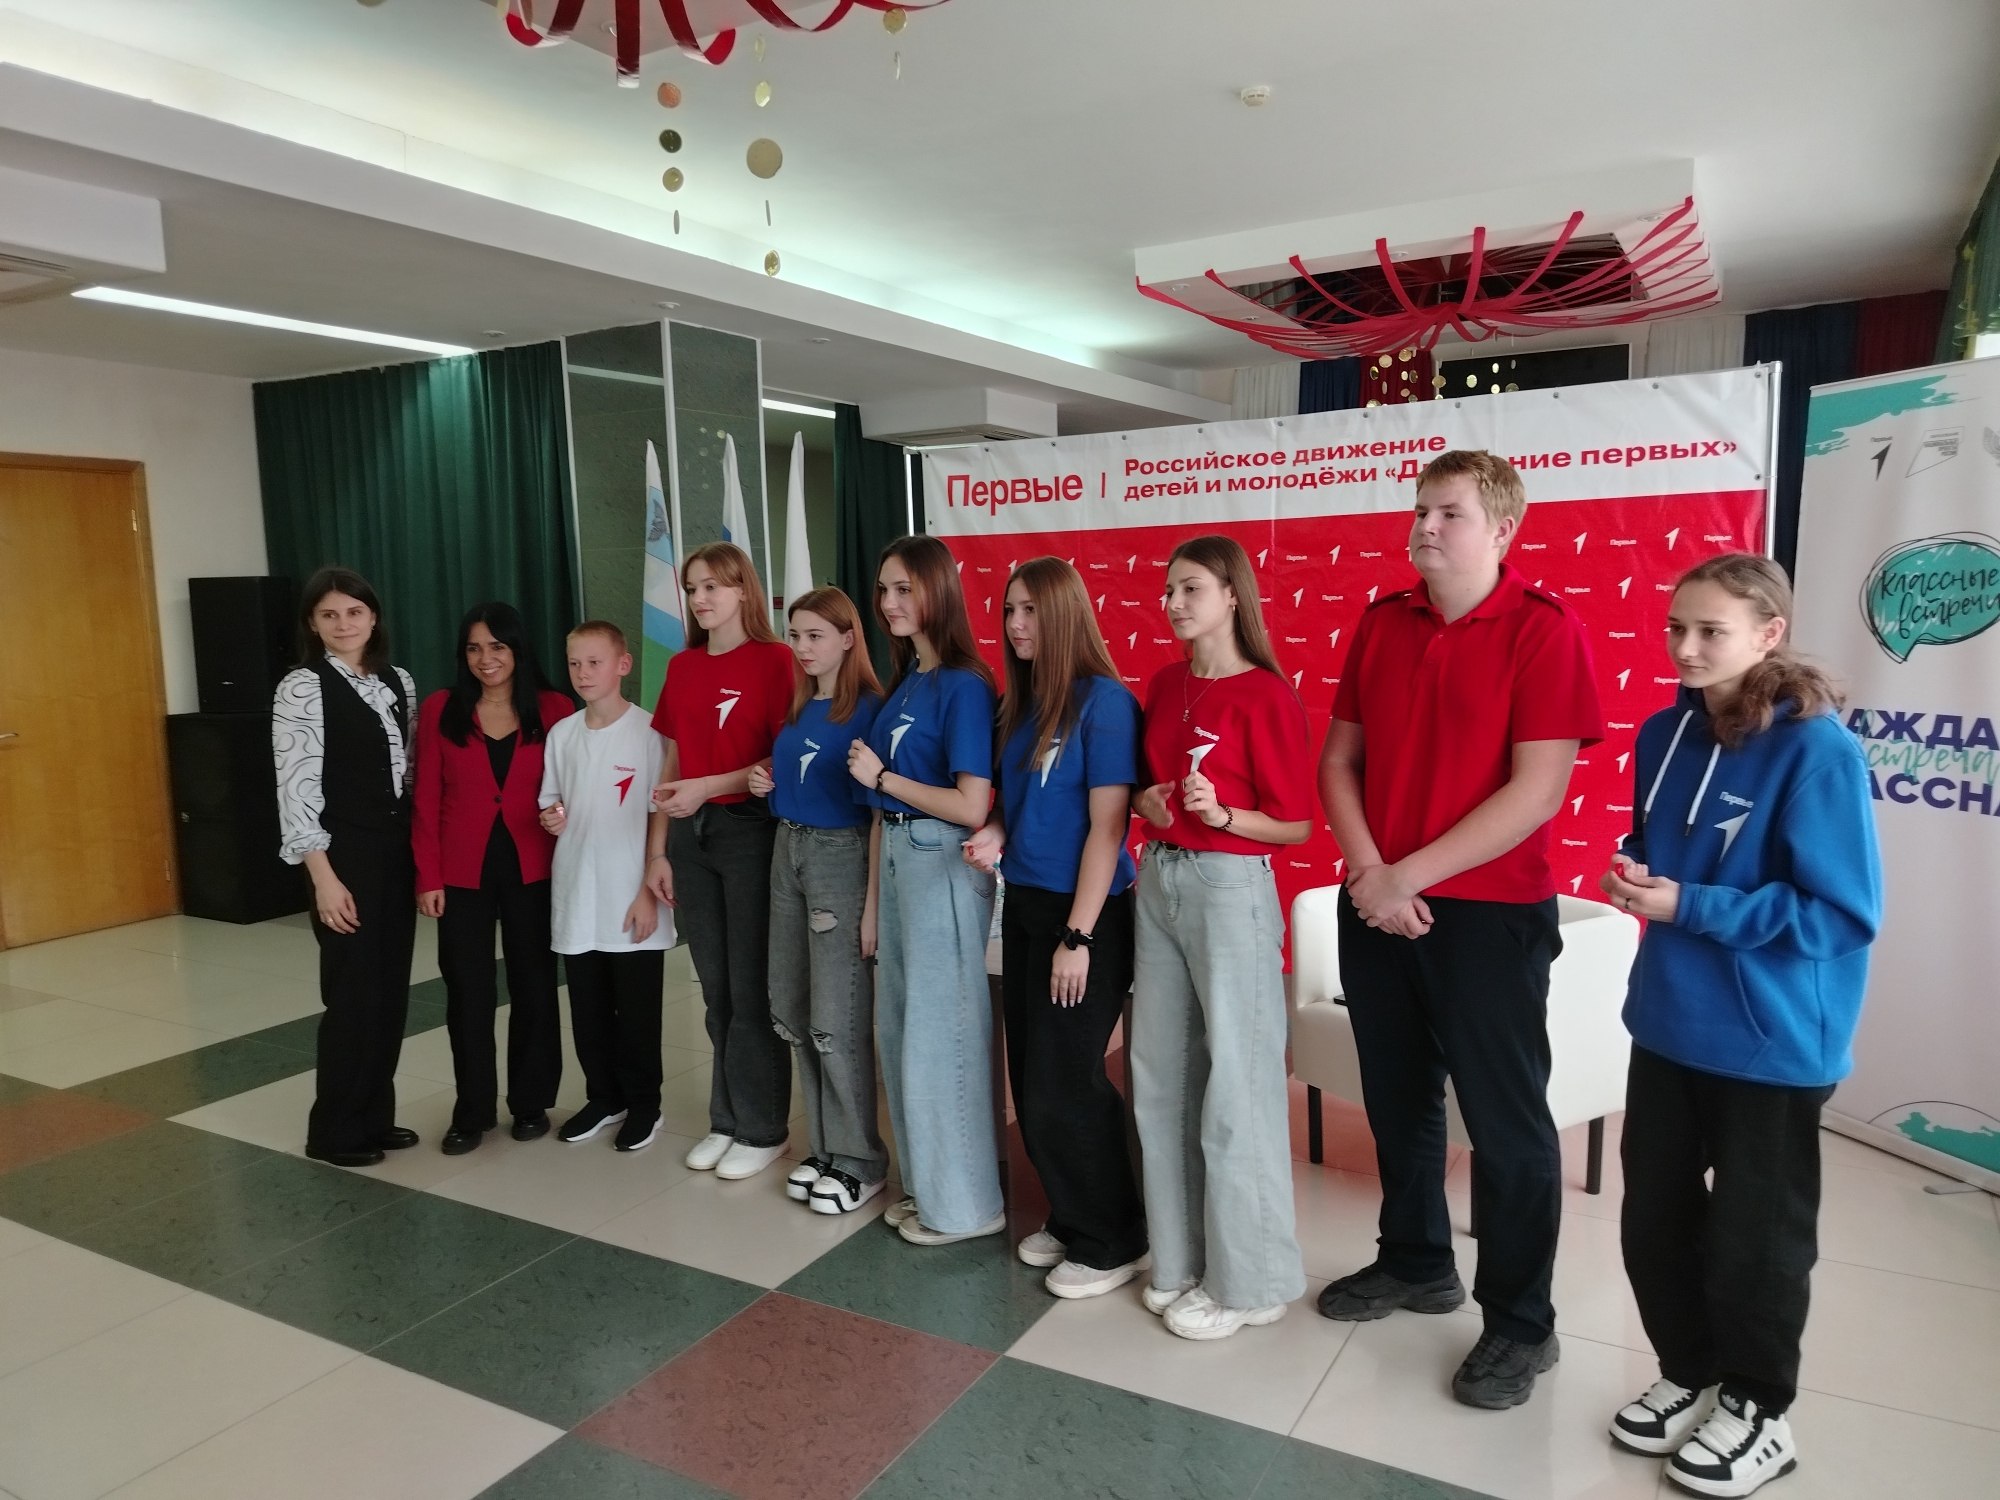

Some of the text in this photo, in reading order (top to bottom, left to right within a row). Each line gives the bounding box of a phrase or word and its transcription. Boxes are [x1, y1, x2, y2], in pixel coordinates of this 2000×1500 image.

[1124, 435, 1446, 477] Российское движение
[1124, 440, 1737, 502] детей и молодёжи «Дние первых»
[947, 474, 1083, 516] Первые
[1521, 543, 1547, 551] Первые
[1609, 538, 1637, 547] Первые
[1564, 586, 1591, 595] Первые
[1869, 769, 2000, 817] ССН
